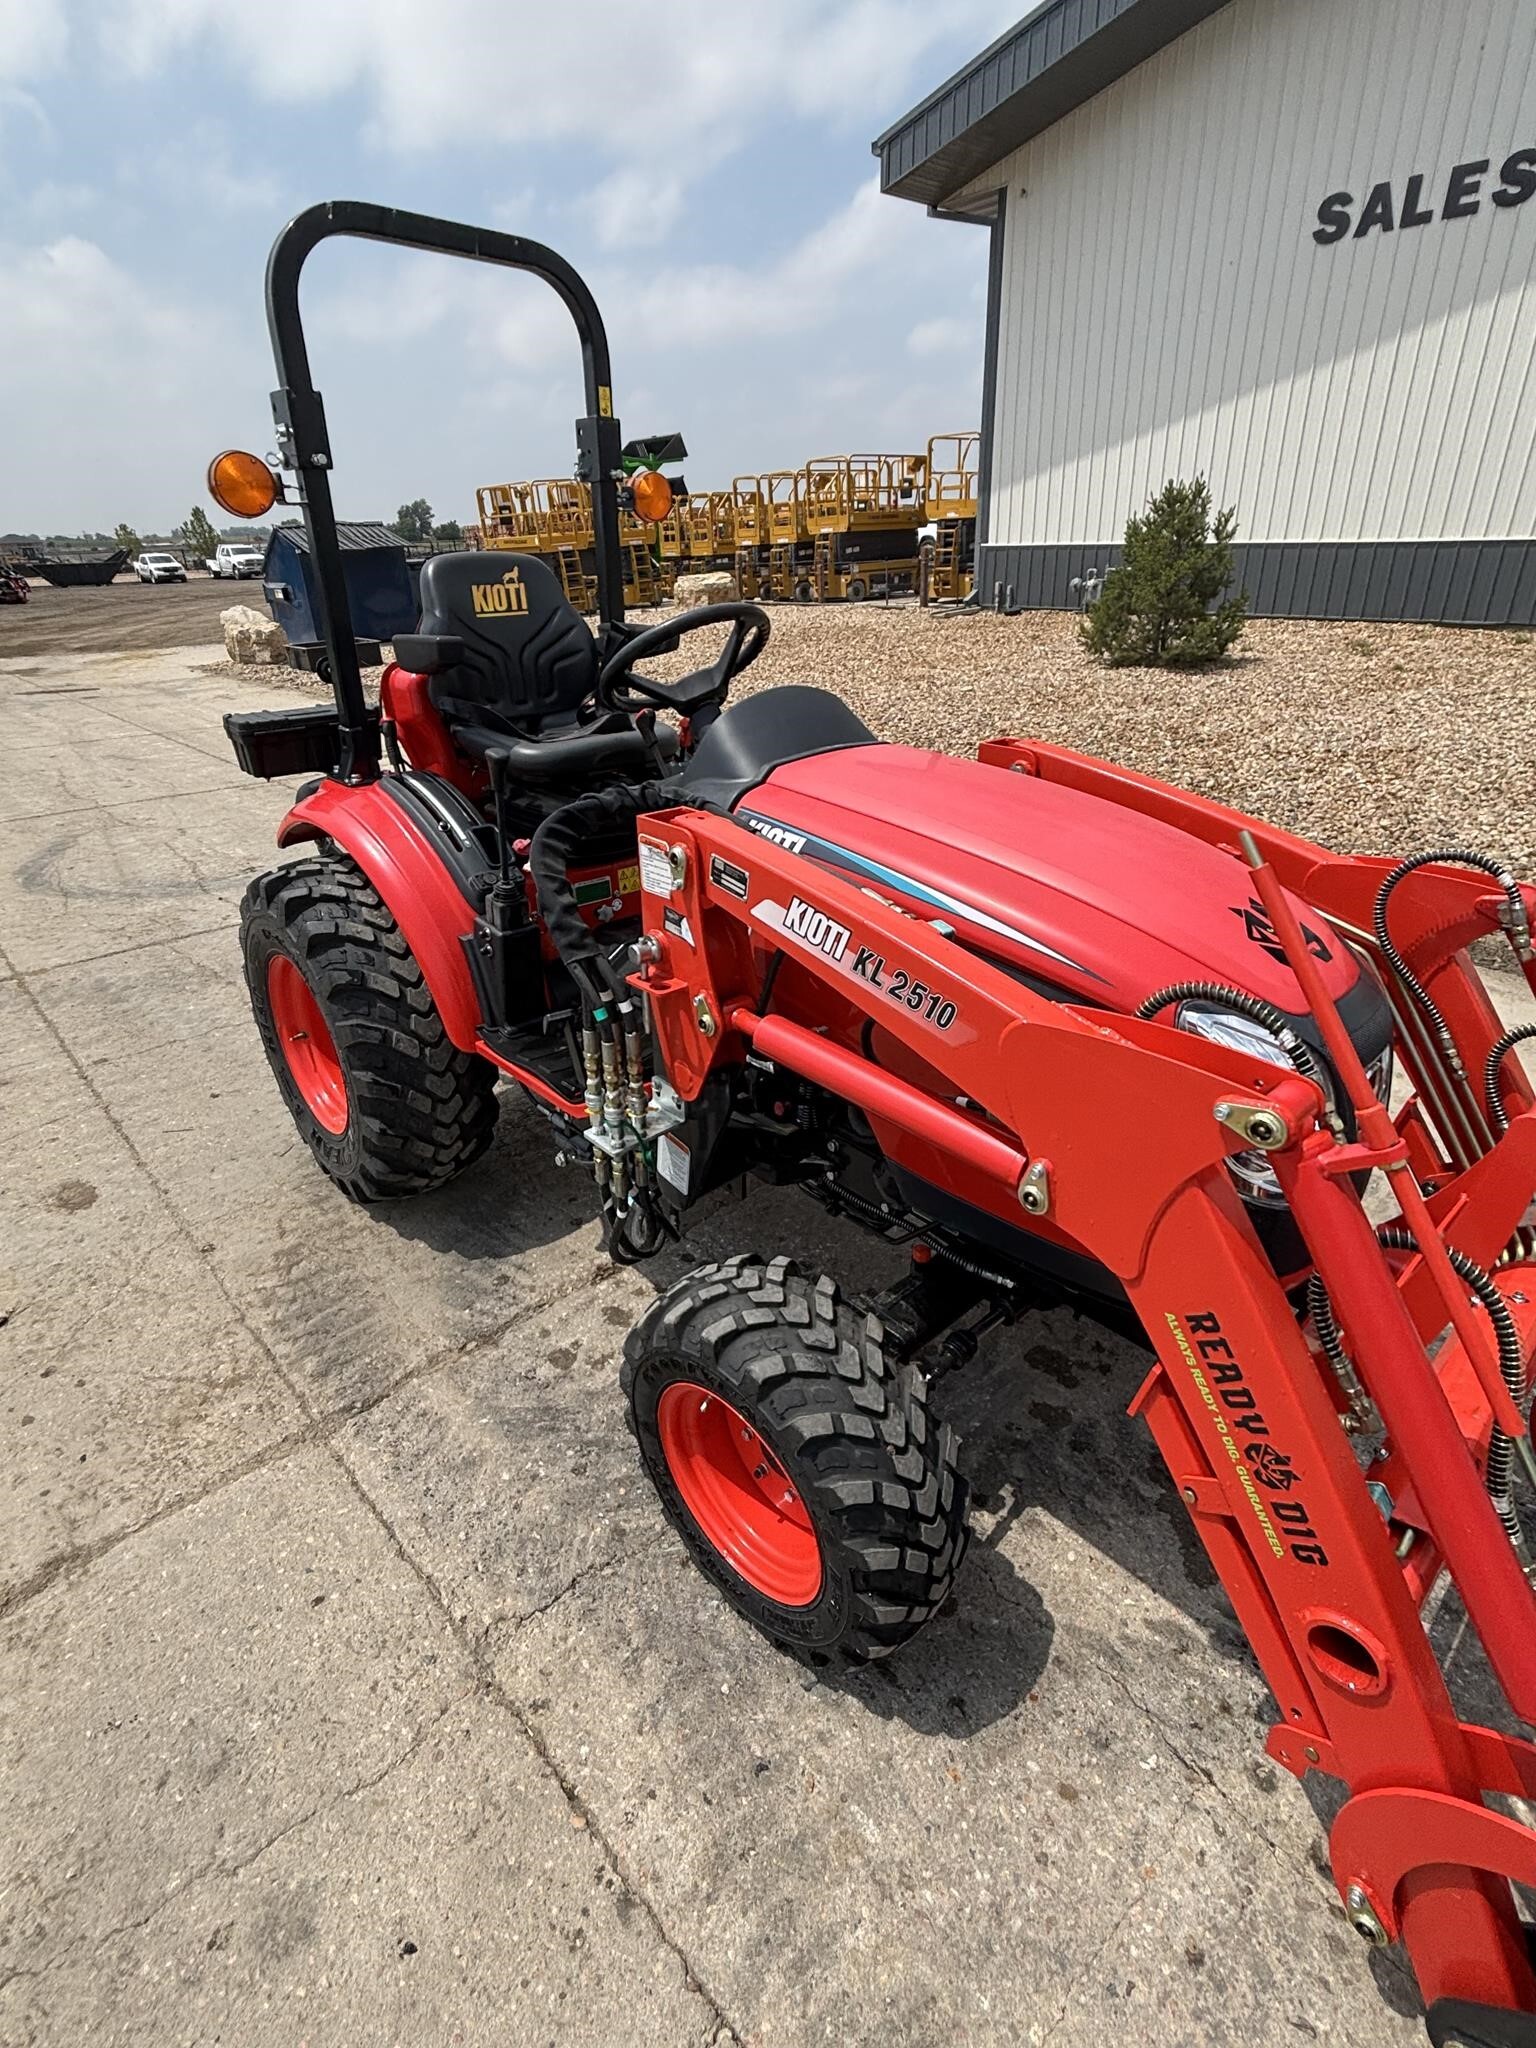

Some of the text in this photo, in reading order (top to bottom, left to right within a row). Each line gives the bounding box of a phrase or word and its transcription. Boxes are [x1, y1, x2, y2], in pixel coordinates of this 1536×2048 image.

[1312, 148, 1536, 245] SALES
[471, 581, 529, 613] KIOTI
[783, 895, 852, 962] KIOTI
[1164, 1312, 1285, 1559] ALWAYS READY TO DIG. GUARANTEED.
[1184, 1311, 1328, 1567] READY DIG
